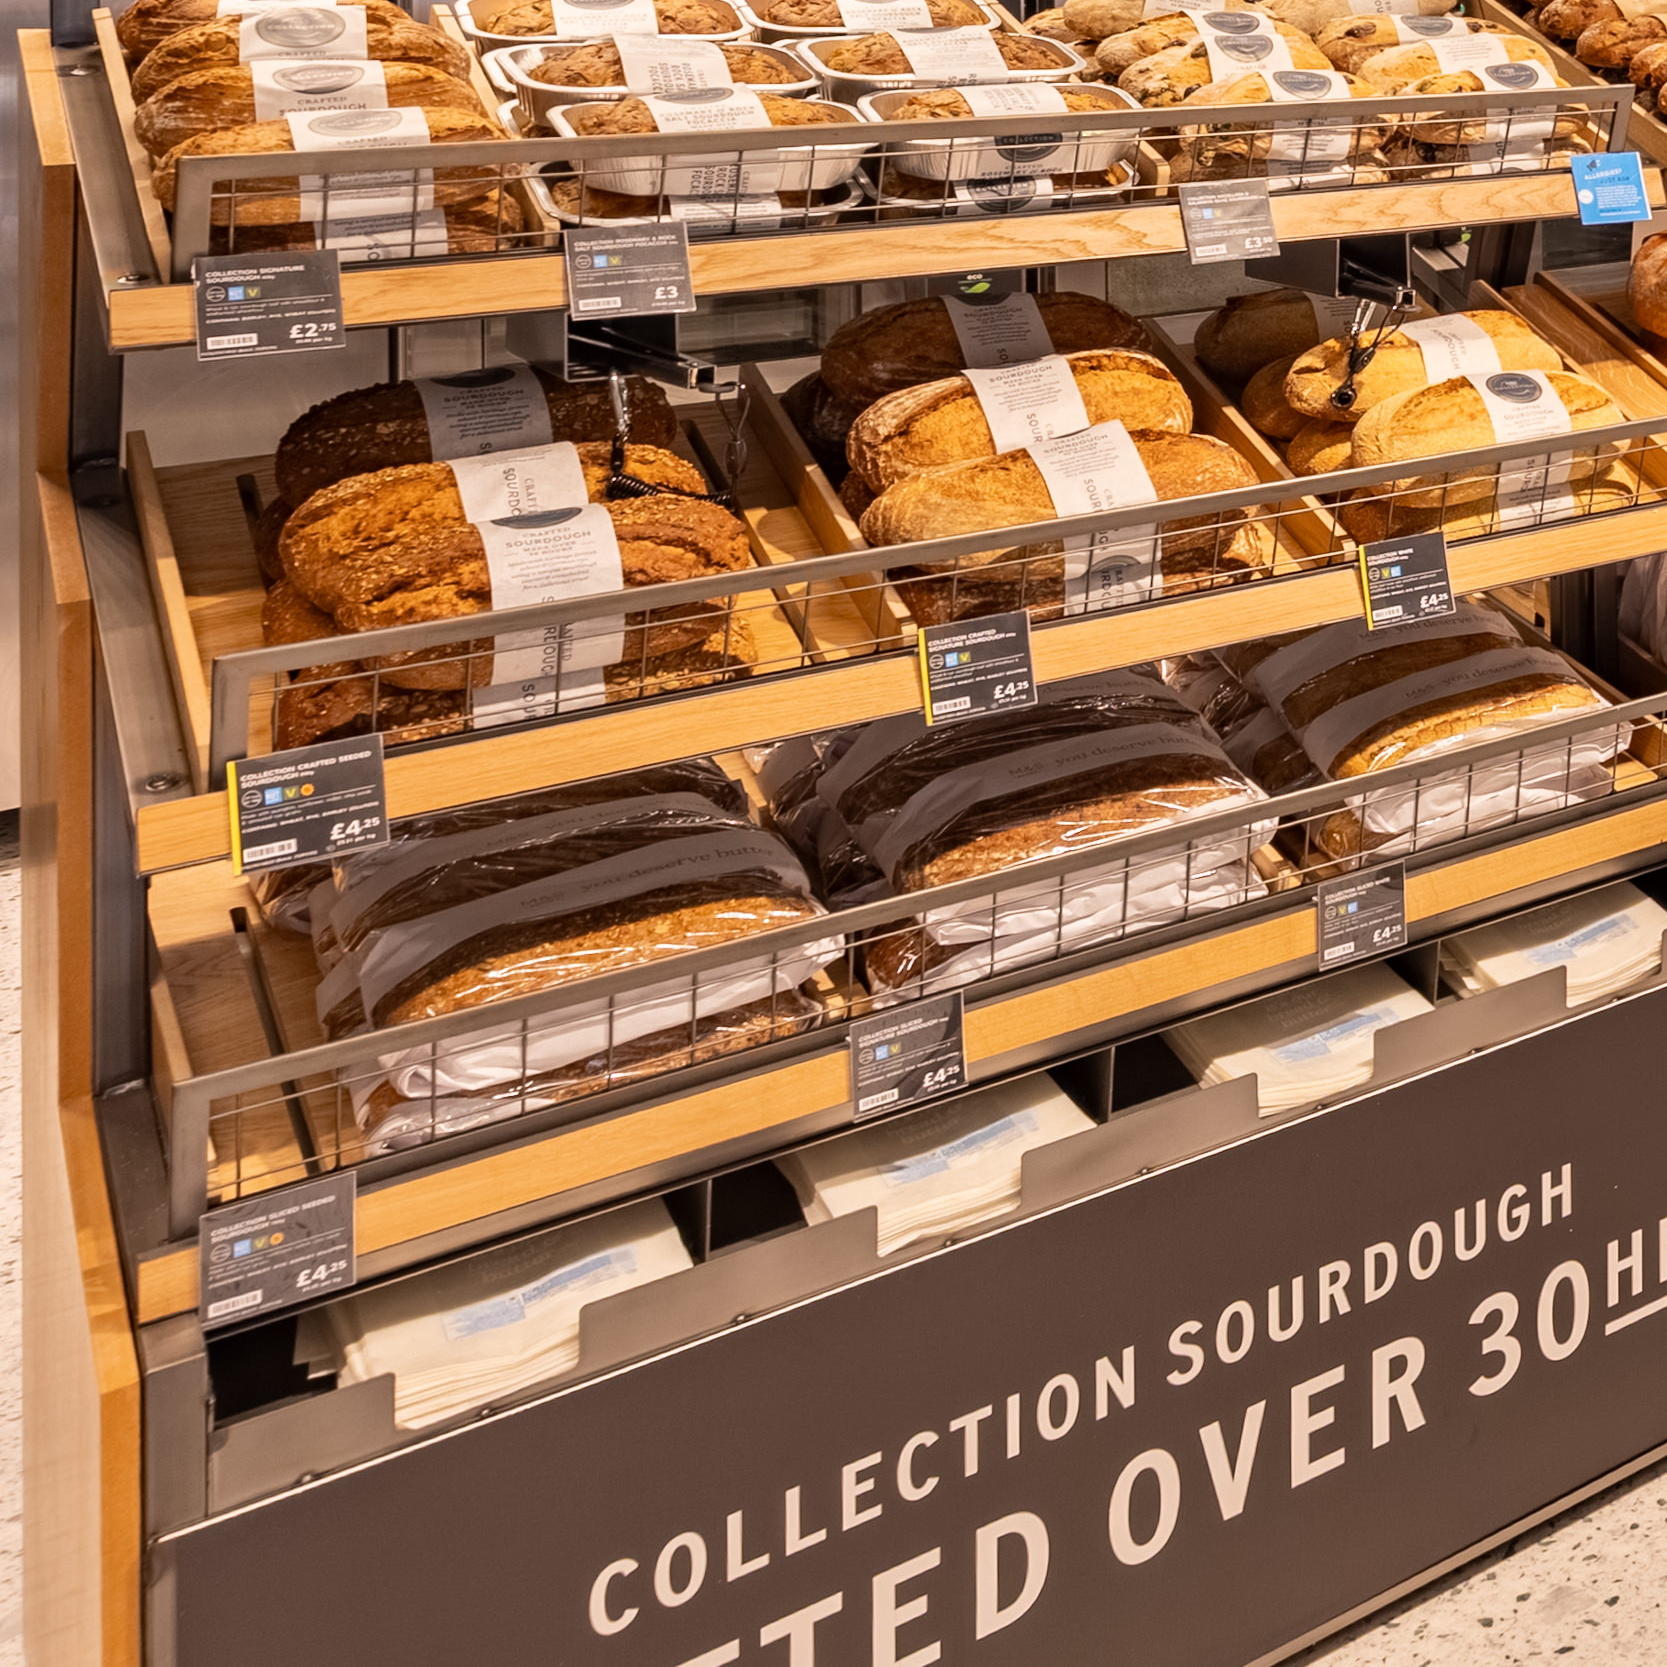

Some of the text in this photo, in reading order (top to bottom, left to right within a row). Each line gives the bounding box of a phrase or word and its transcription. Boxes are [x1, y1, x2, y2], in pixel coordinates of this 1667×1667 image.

[297, 95, 347, 106] CRAFTED
[687, 117, 737, 126] FOCACCIA
[694, 111, 755, 121] SOURDOUGH
[1002, 134, 1057, 144] COLLECTION
[574, 240, 614, 248] COLLECTION
[592, 243, 634, 251] SOURDOUGH
[205, 265, 305, 278] COLLECTION SIGNATURE
[206, 275, 260, 284] SOURDOUGH
[655, 285, 679, 300] £3
[963, 308, 1023, 318] SOURDOUGH
[289, 322, 337, 339] £2.75
[989, 366, 1053, 382] SOURDOUGH
[444, 390, 524, 403] SOURDOUGH
[1503, 409, 1554, 420] SOURDOUGH
[1026, 413, 1043, 443] SOUR
[1044, 435, 1109, 454] SOURDOUGH
[505, 531, 591, 549] SOURDOUGH
[522, 527, 570, 538] CRAFTED
[1420, 593, 1449, 609] £4.25
[1422, 614, 1470, 628] deserve
[928, 629, 997, 647] COLLECTION CRAFTED
[928, 633, 1005, 653] SIGNATURE SOURDOUGH
[1442, 670, 1471, 686] you
[1471, 658, 1526, 679] deserve
[993, 680, 1030, 700] £4.25
[240, 750, 373, 782] COLLECTION CRAFTED SEEDED
[1008, 737, 1157, 778] M&S you deserve
[241, 772, 299, 789] SOURDOUGH
[330, 817, 381, 841] £4.25
[520, 891, 564, 908] M&S
[579, 873, 621, 893] you
[629, 852, 711, 879] deserve
[1372, 924, 1402, 943] £4.25
[859, 1018, 923, 1042] COLLECTION SLICED
[859, 1019, 938, 1048] SIGNATURE SOURDOUGH
[922, 1064, 960, 1088] £4.25
[210, 1195, 336, 1237] COLLECTION SLICED SEEDED
[211, 1222, 269, 1244] SOURDOUGH
[296, 1259, 348, 1288] £4.25
[588, 1163, 1573, 1635] COLLECTION SOURDOUGH
[675, 1511, 1049, 1667] TED
[1108, 1335, 1427, 1566] OVER
